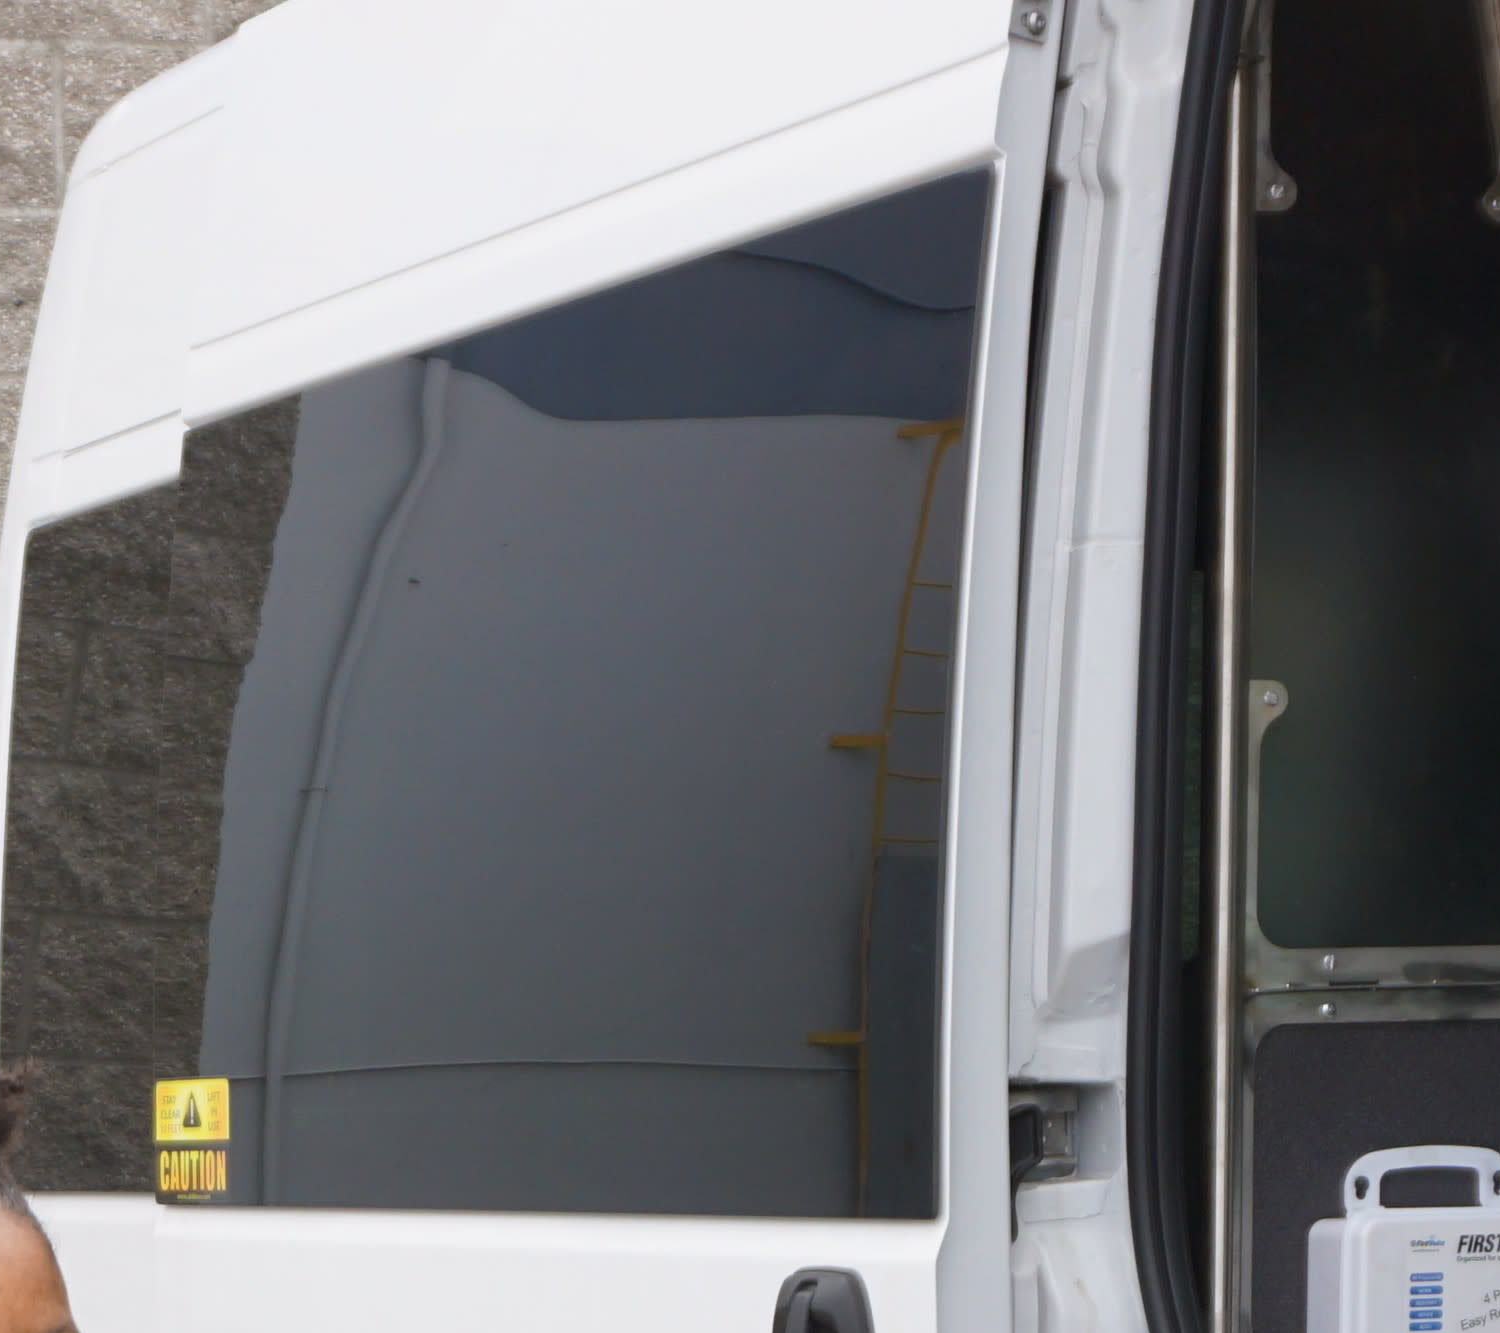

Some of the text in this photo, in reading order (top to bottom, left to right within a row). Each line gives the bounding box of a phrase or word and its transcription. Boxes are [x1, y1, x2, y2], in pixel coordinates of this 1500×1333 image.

[160, 1150, 226, 1191] CAUTION
[1483, 1293, 1491, 1304] 4
[1460, 1312, 1487, 1331] Easy
